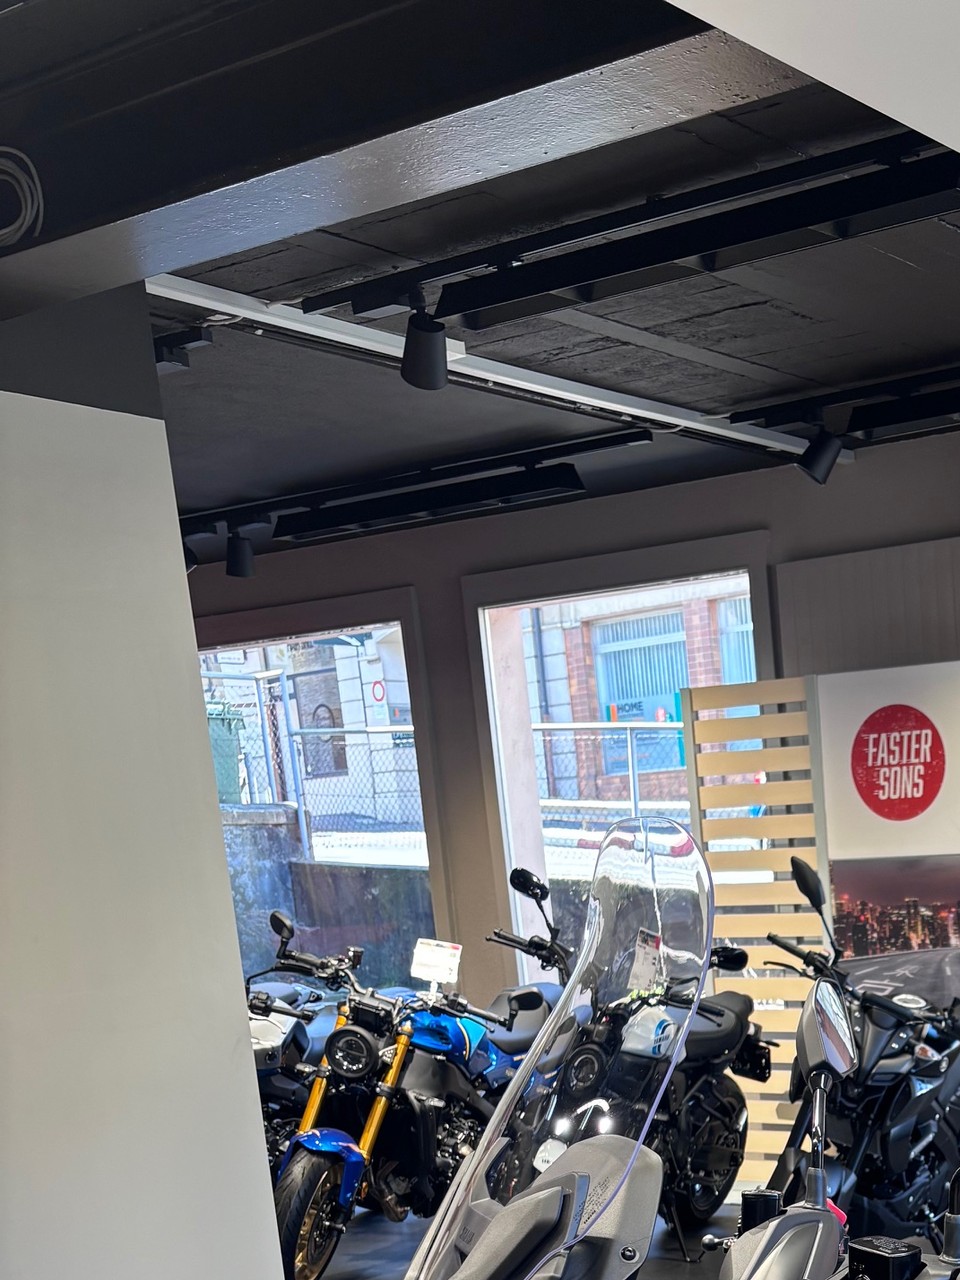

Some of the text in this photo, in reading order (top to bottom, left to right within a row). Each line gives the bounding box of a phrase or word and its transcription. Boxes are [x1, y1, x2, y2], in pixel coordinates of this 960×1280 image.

[616, 700, 644, 714] HOME
[865, 729, 932, 767] FASTER
[877, 764, 925, 800] SONS
